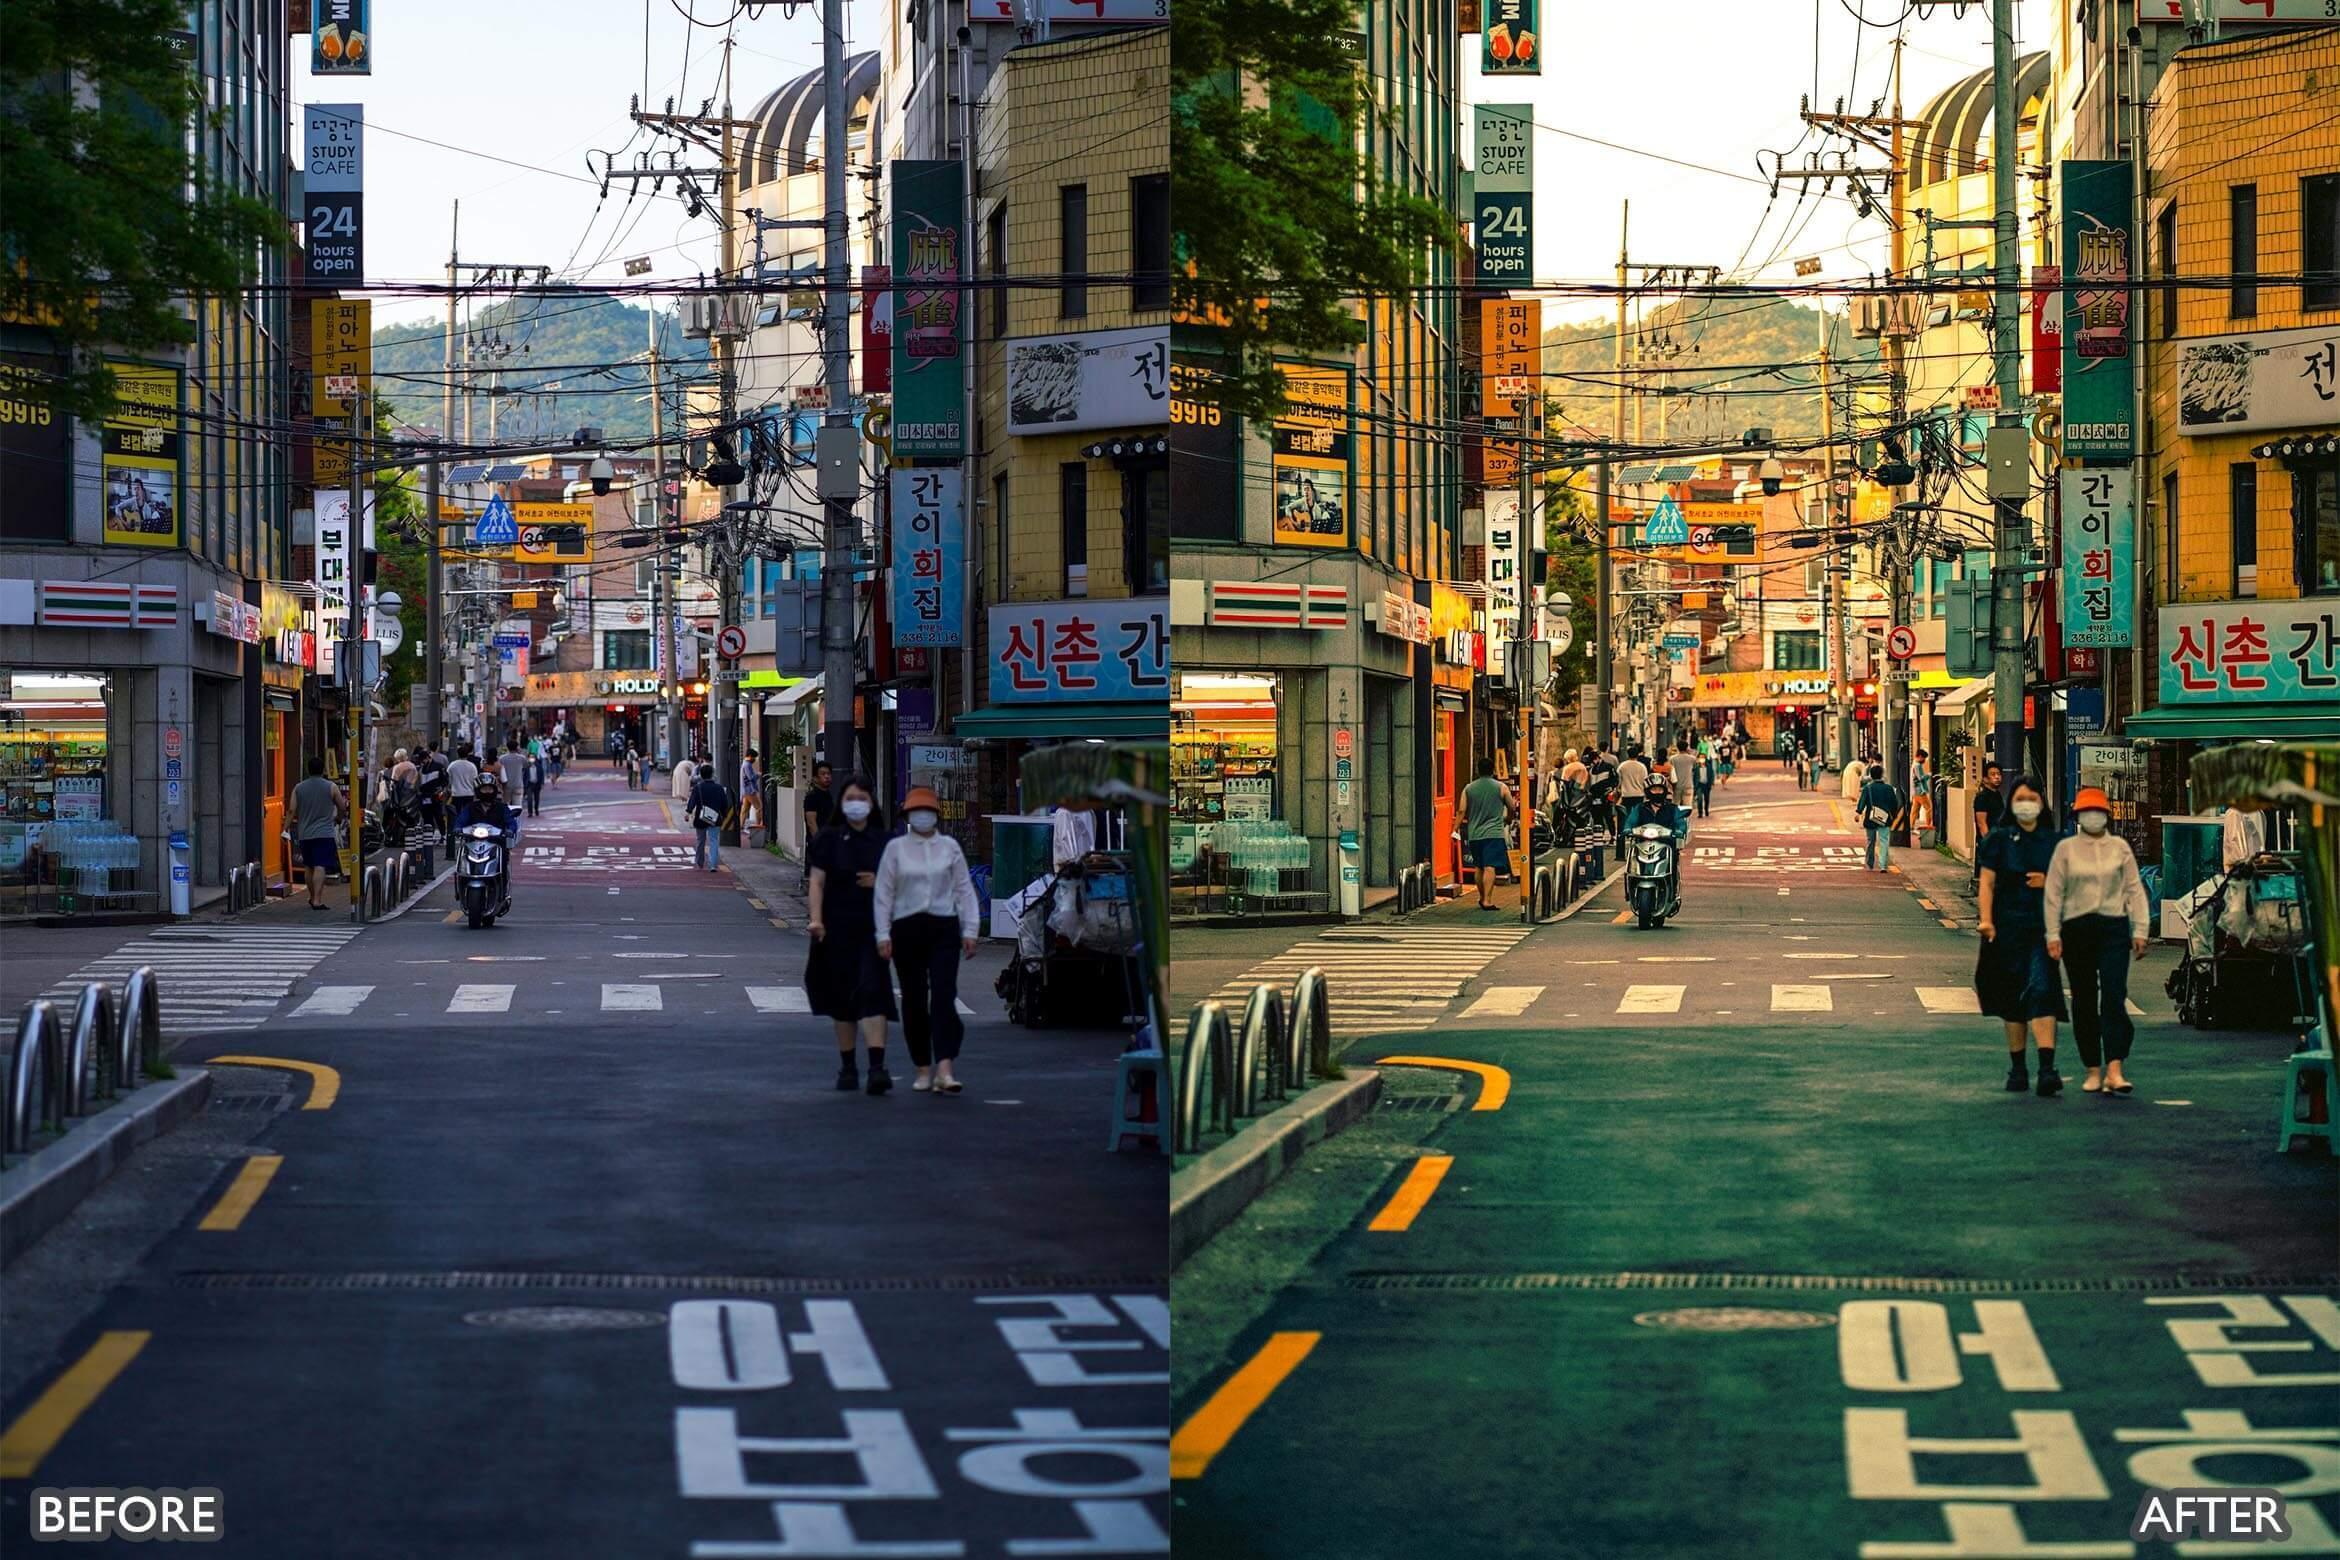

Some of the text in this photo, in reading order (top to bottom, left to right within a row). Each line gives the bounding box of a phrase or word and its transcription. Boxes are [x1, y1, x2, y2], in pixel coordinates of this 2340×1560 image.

[312, 146, 356, 158] STUDY
[1482, 146, 1526, 158] STUDY
[311, 161, 356, 175] CAFE
[1481, 161, 1526, 175] CAFE
[312, 206, 358, 237] 24
[1482, 206, 1528, 237] 24
[313, 243, 355, 256] hours
[1483, 243, 1525, 256] hours
[312, 258, 355, 275] open
[896, 228, 957, 329] 麻雀
[1482, 258, 1525, 275] open
[2066, 228, 2127, 329] 麻雀
[338, 305, 359, 353] 피아노
[1508, 305, 1529, 353] 피아노
[1130, 342, 1166, 401] 전
[2300, 342, 2336, 401] 전
[0, 398, 52, 426] 9915
[1170, 398, 1222, 426] 9915
[911, 474, 943, 620] 간이회집
[2081, 474, 2113, 620] 간이회집
[375, 628, 399, 641] LLIS
[901, 632, 958, 643] 336-2116
[1545, 628, 1569, 641] LLIS
[2071, 632, 2128, 643] 336-2116
[1000, 616, 1101, 689] 신촌
[2170, 616, 2271, 689] 신촌
